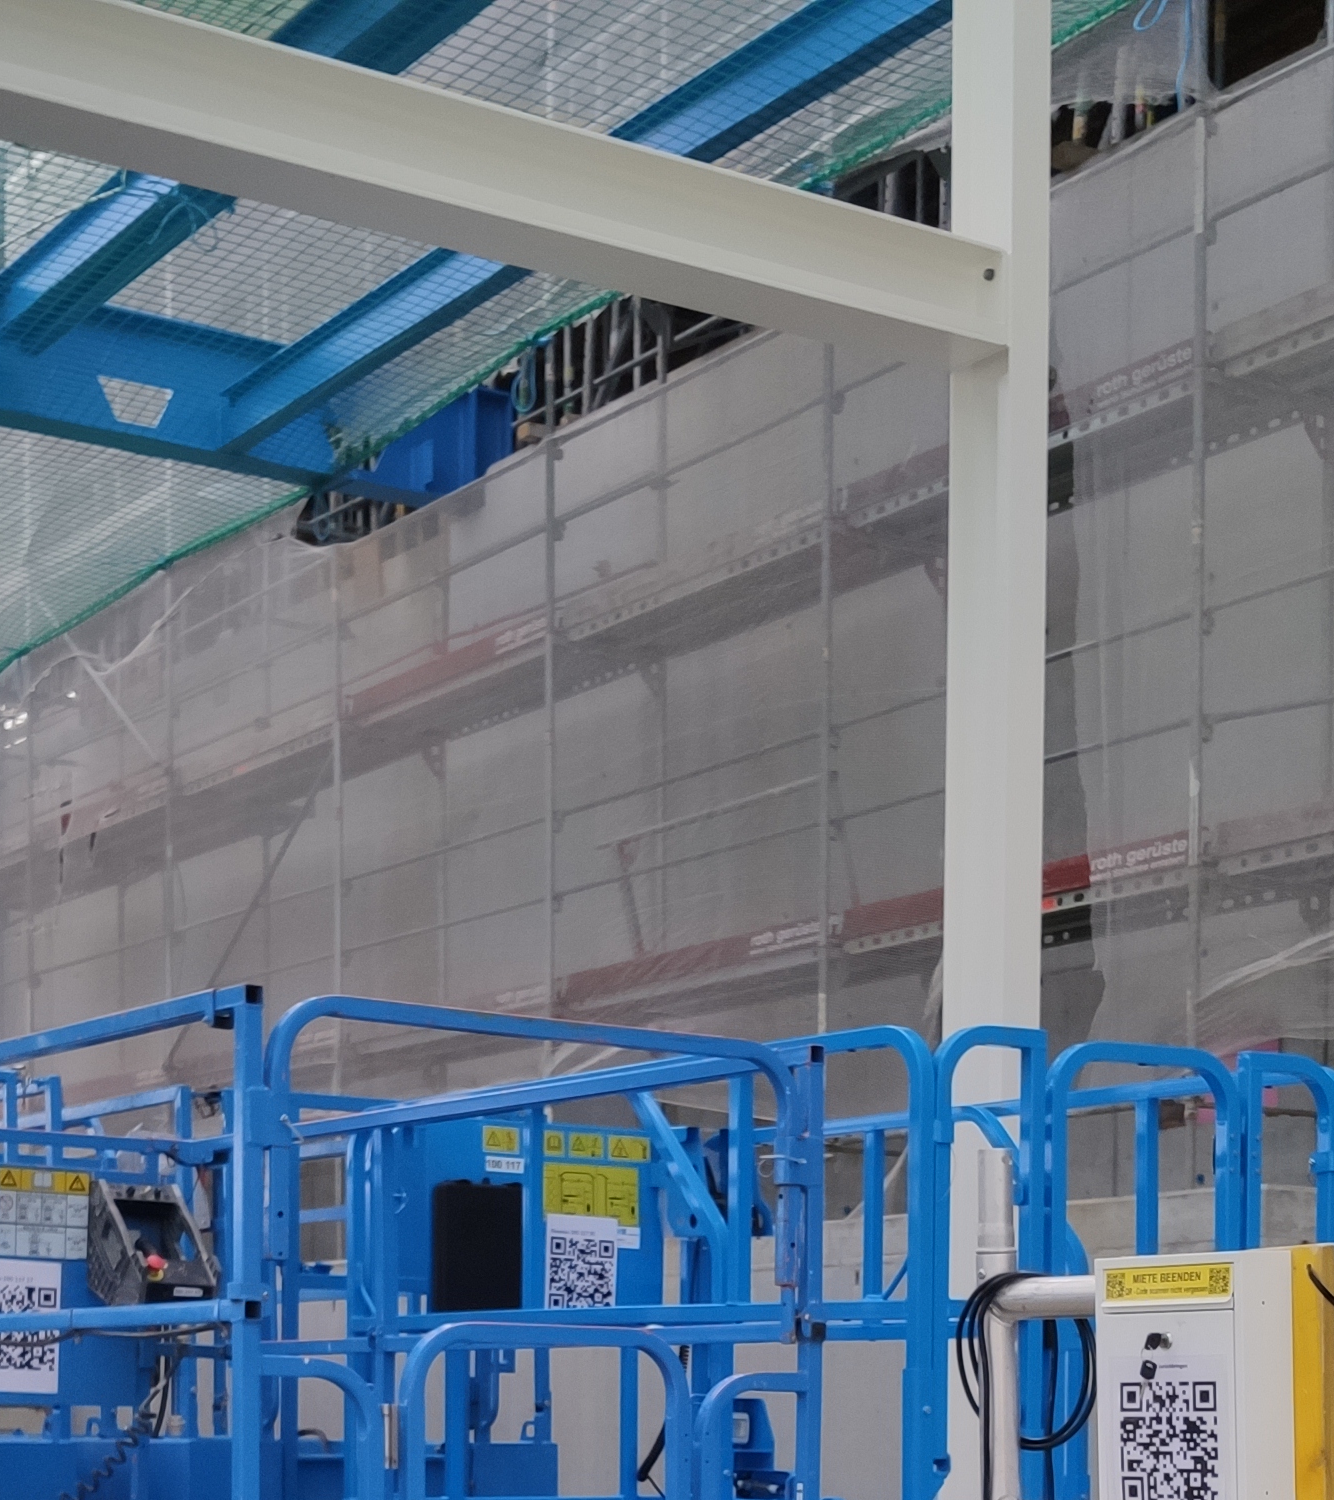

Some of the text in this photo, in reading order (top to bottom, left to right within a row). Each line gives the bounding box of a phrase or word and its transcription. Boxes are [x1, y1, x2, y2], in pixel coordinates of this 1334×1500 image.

[1090, 852, 1122, 872] roth
[1132, 1271, 1202, 1283] MIETE BEENDEN
